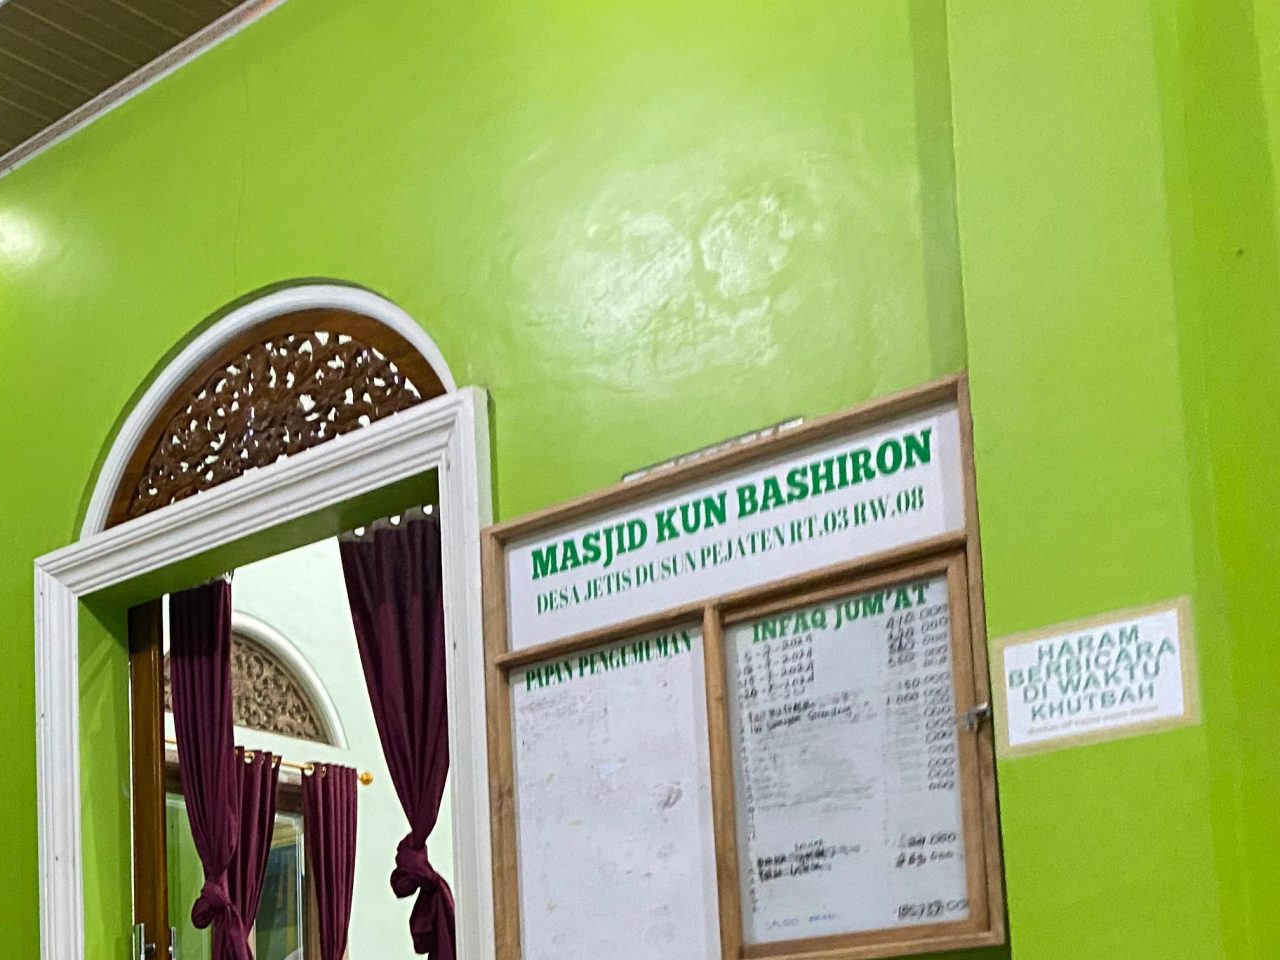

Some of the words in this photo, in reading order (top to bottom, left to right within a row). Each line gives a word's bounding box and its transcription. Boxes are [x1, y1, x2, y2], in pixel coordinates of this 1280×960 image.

[531, 518, 648, 580] MASJID
[655, 491, 727, 543] KUN
[736, 426, 932, 519] BASHIRON
[537, 583, 580, 615] DESA
[584, 569, 632, 601] JETIS
[636, 549, 696, 587] DUSUN
[700, 524, 785, 568] PEJATEN
[752, 607, 828, 644] INFAQ
[1038, 624, 1139, 661] HARAM
[526, 660, 573, 692] PAPAN
[578, 630, 691, 677] PENGUMUMAN
[1009, 637, 1176, 688] BERBICARA
[1023, 682, 1048, 703] DI
[1058, 659, 1161, 695] WAKTU
[1031, 681, 1154, 721] KHUTBAH
